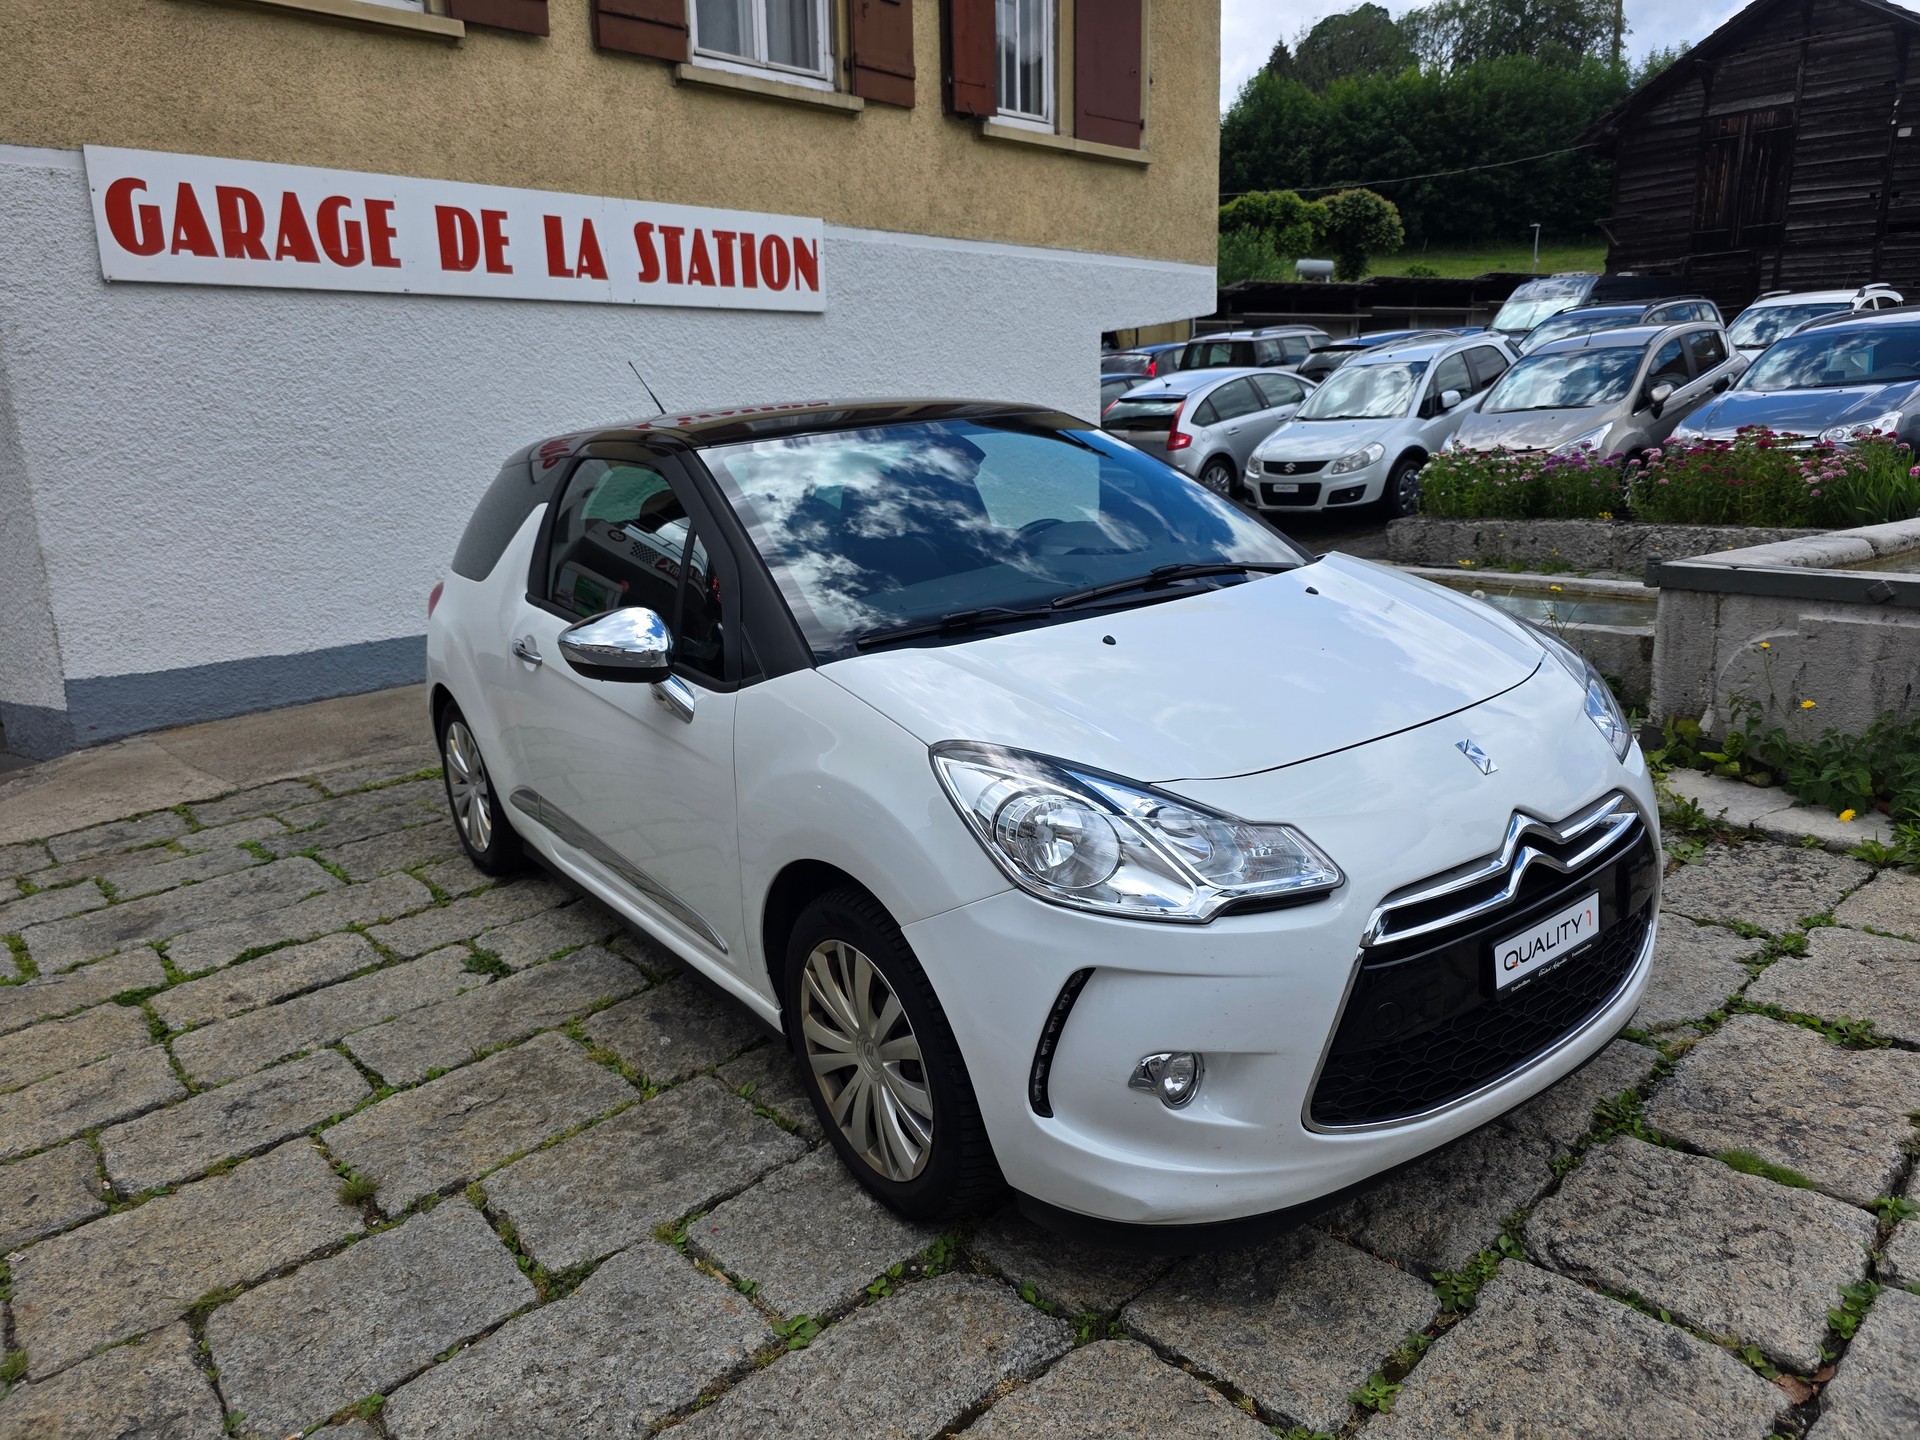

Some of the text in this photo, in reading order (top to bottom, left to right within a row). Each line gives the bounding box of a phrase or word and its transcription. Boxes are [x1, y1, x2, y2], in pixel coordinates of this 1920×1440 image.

[104, 177, 819, 292] GARAGE DE LA STATION
[1503, 913, 1583, 971] QUALITY
[1585, 908, 1592, 927] 1
